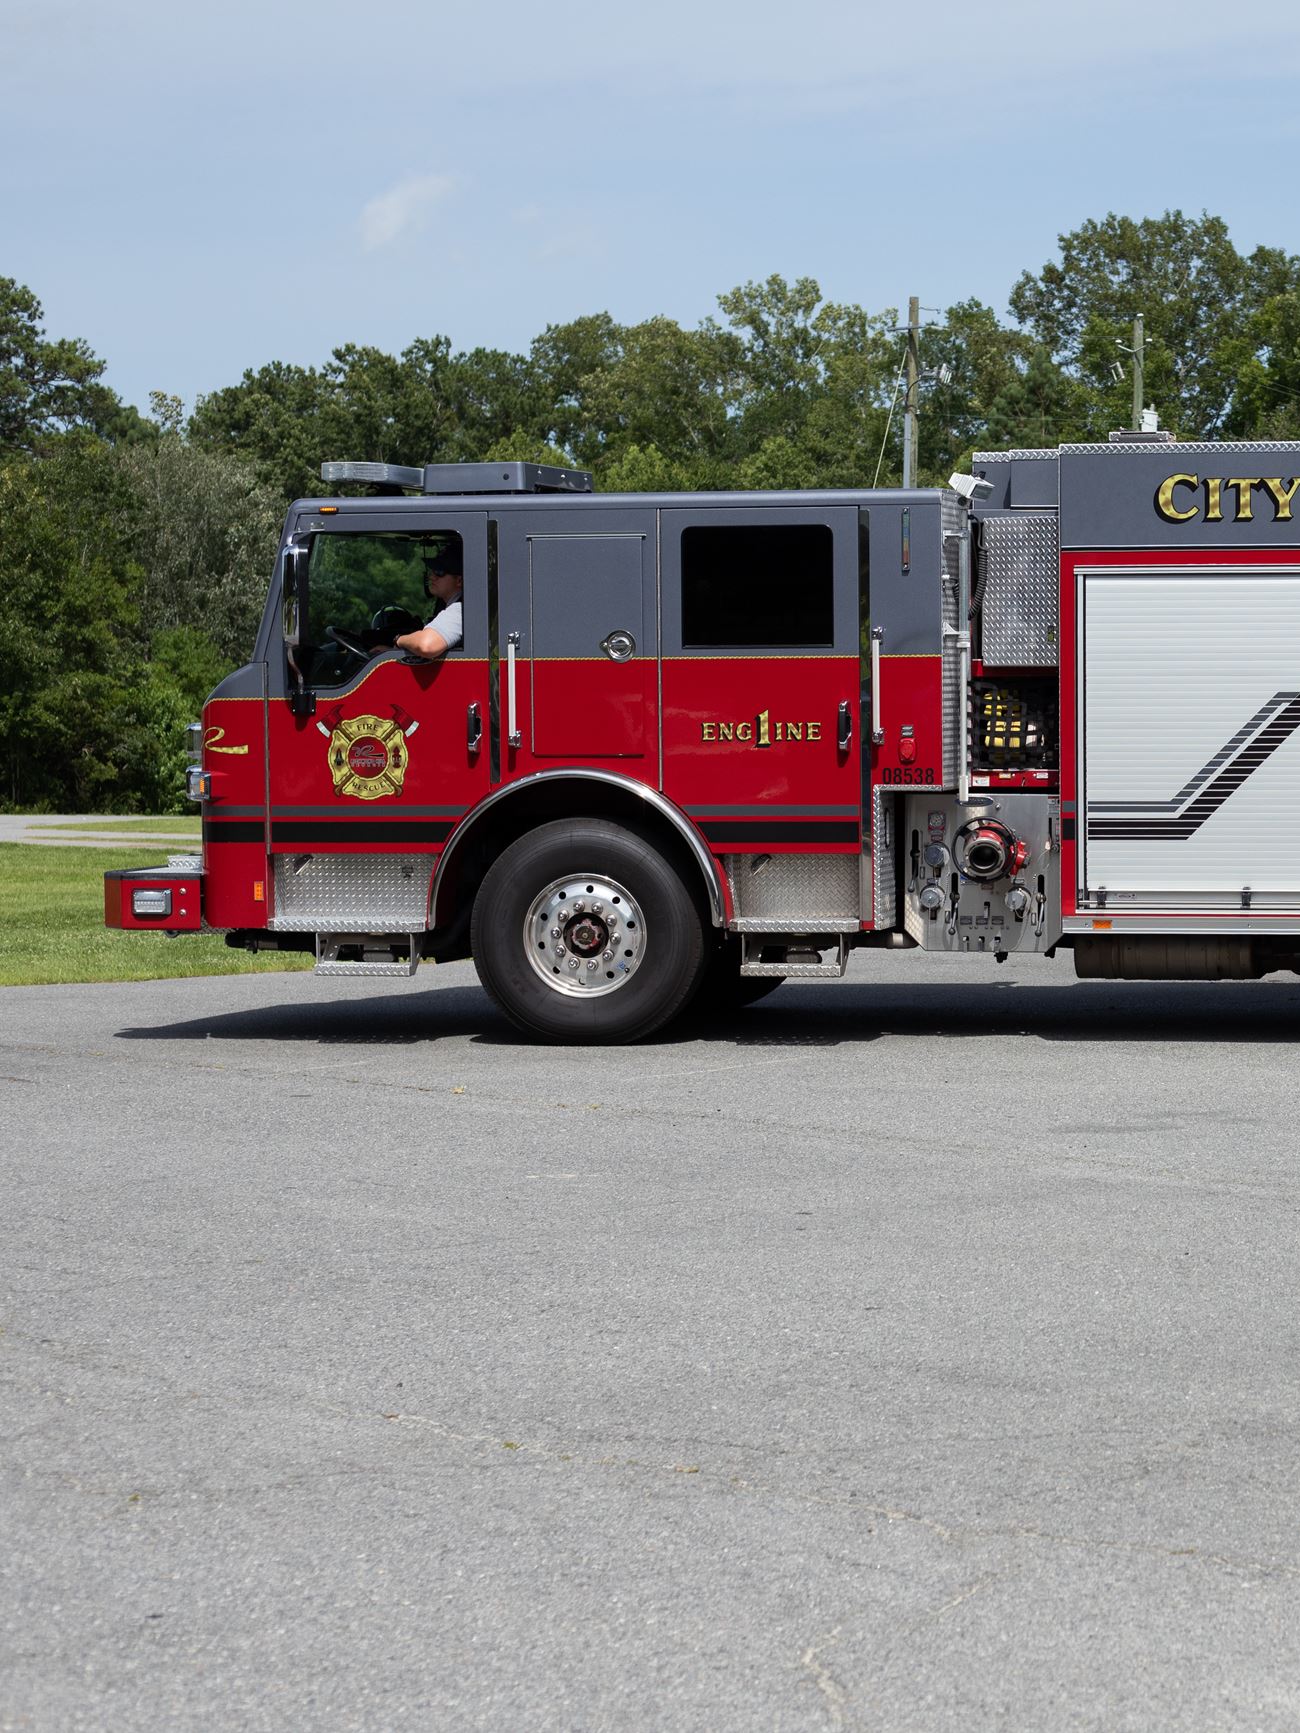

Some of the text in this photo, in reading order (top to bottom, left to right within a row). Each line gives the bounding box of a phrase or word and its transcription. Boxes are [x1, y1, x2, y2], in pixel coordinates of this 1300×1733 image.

[356, 723, 379, 732] FIRE
[882, 767, 935, 785] 08538
[351, 782, 386, 792] RESCUE
